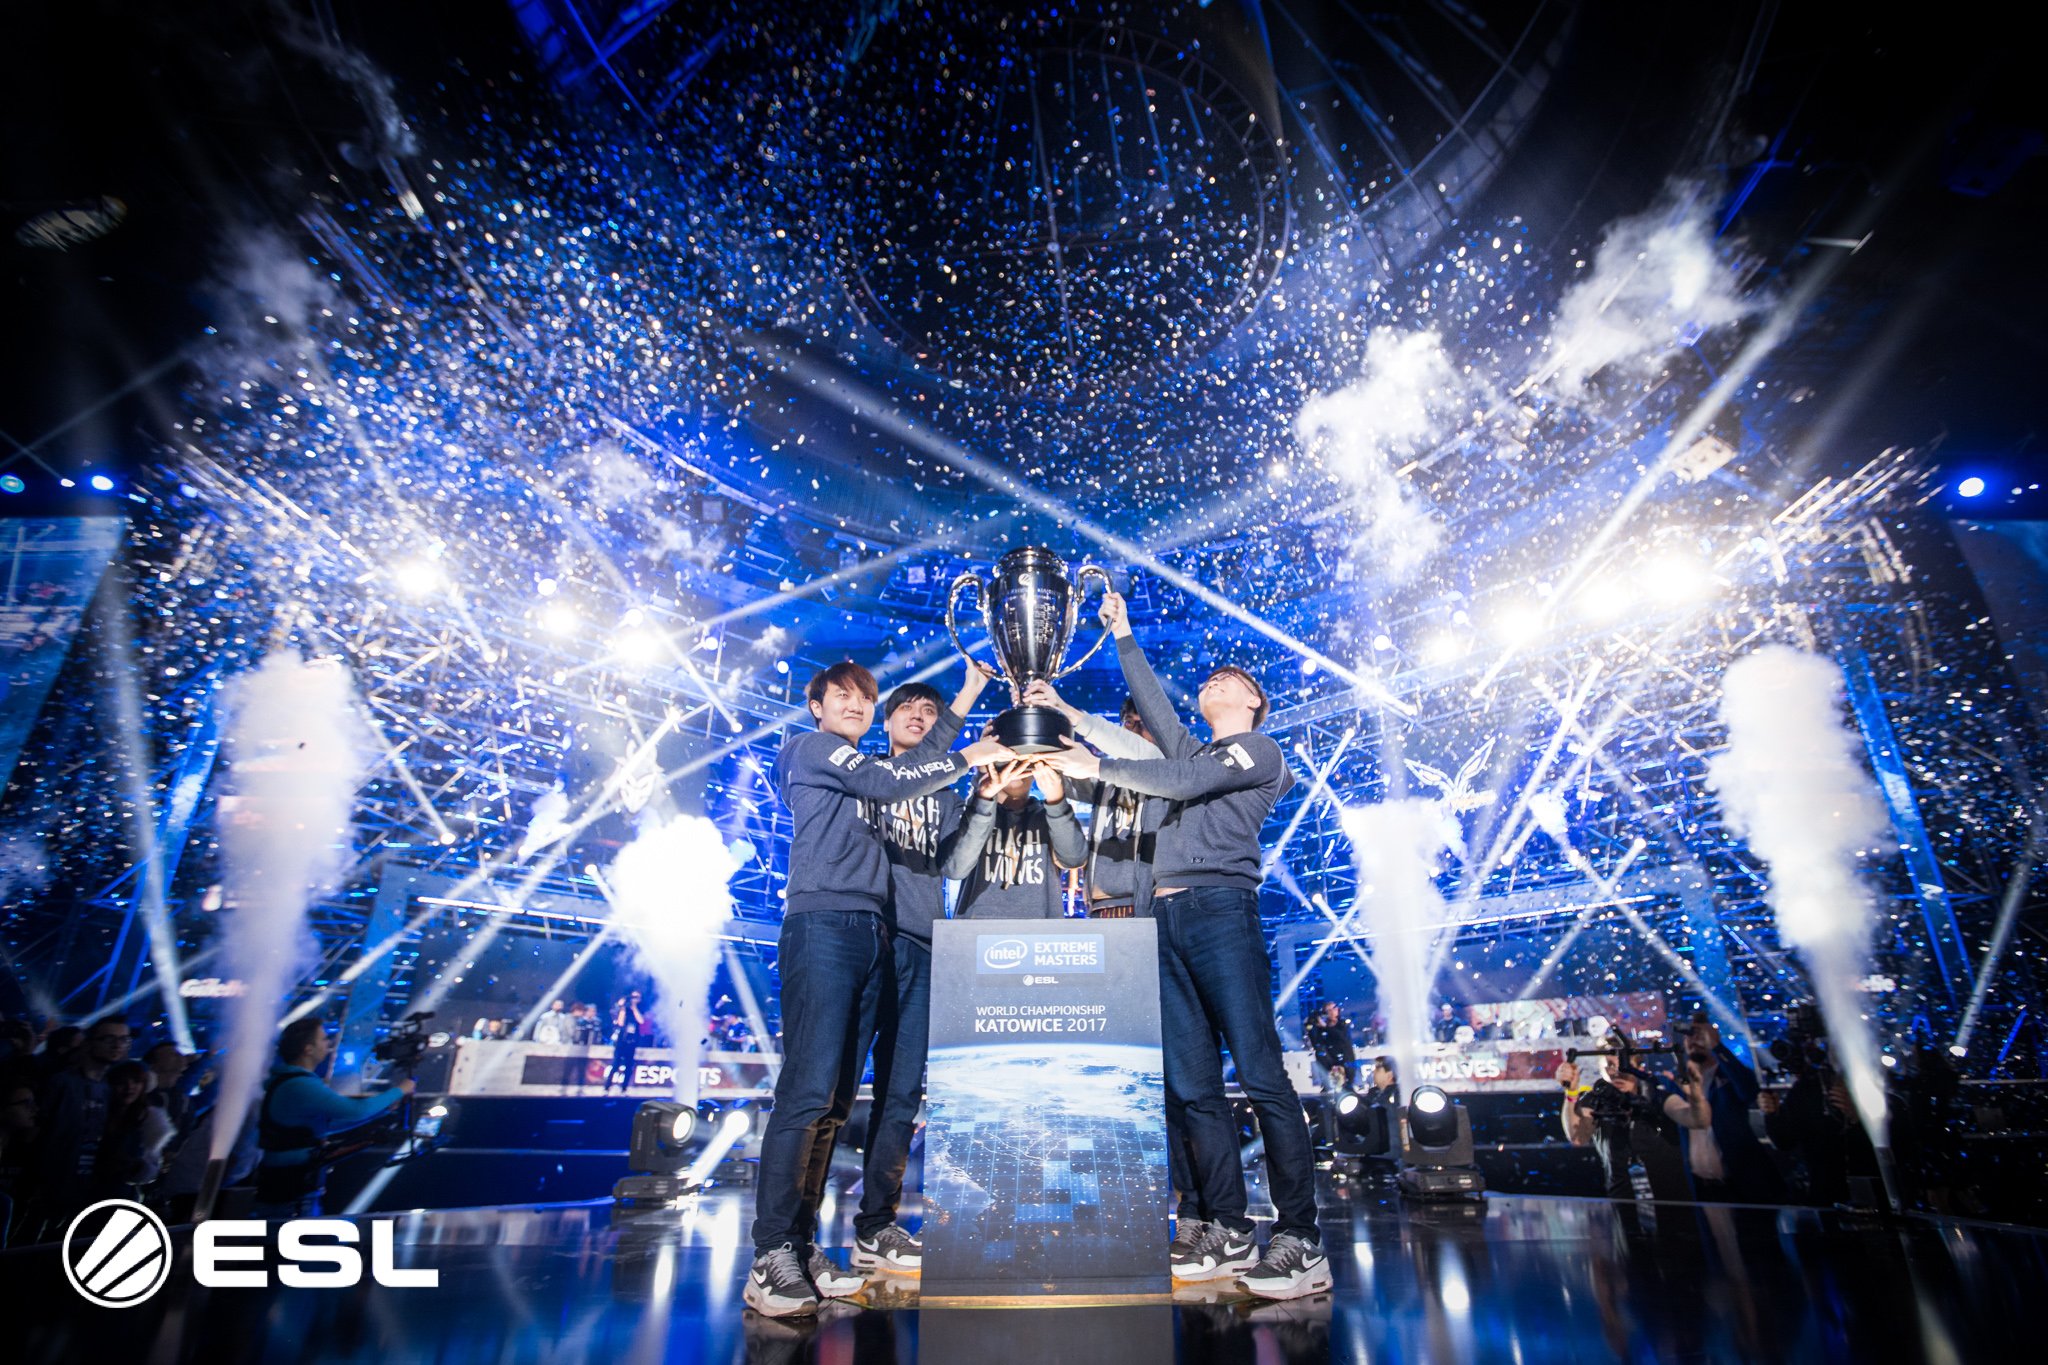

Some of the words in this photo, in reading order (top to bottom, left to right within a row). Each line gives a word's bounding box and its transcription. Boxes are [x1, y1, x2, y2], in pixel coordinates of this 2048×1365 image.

[920, 758, 956, 776] Flash
[881, 796, 940, 825] LASH
[989, 946, 1021, 960] intel
[1034, 941, 1097, 953] EXTREME
[1034, 954, 1097, 966] MASTERS
[1034, 976, 1059, 984] ESL
[976, 1006, 1018, 1016] WORLD
[1019, 1005, 1106, 1016] CHAMPIONSHIP
[975, 1018, 1063, 1033] KATOWICE
[1067, 1017, 1107, 1032] 2017
[634, 1065, 722, 1086] ESPTS
[1415, 1059, 1500, 1080] WOLVES
